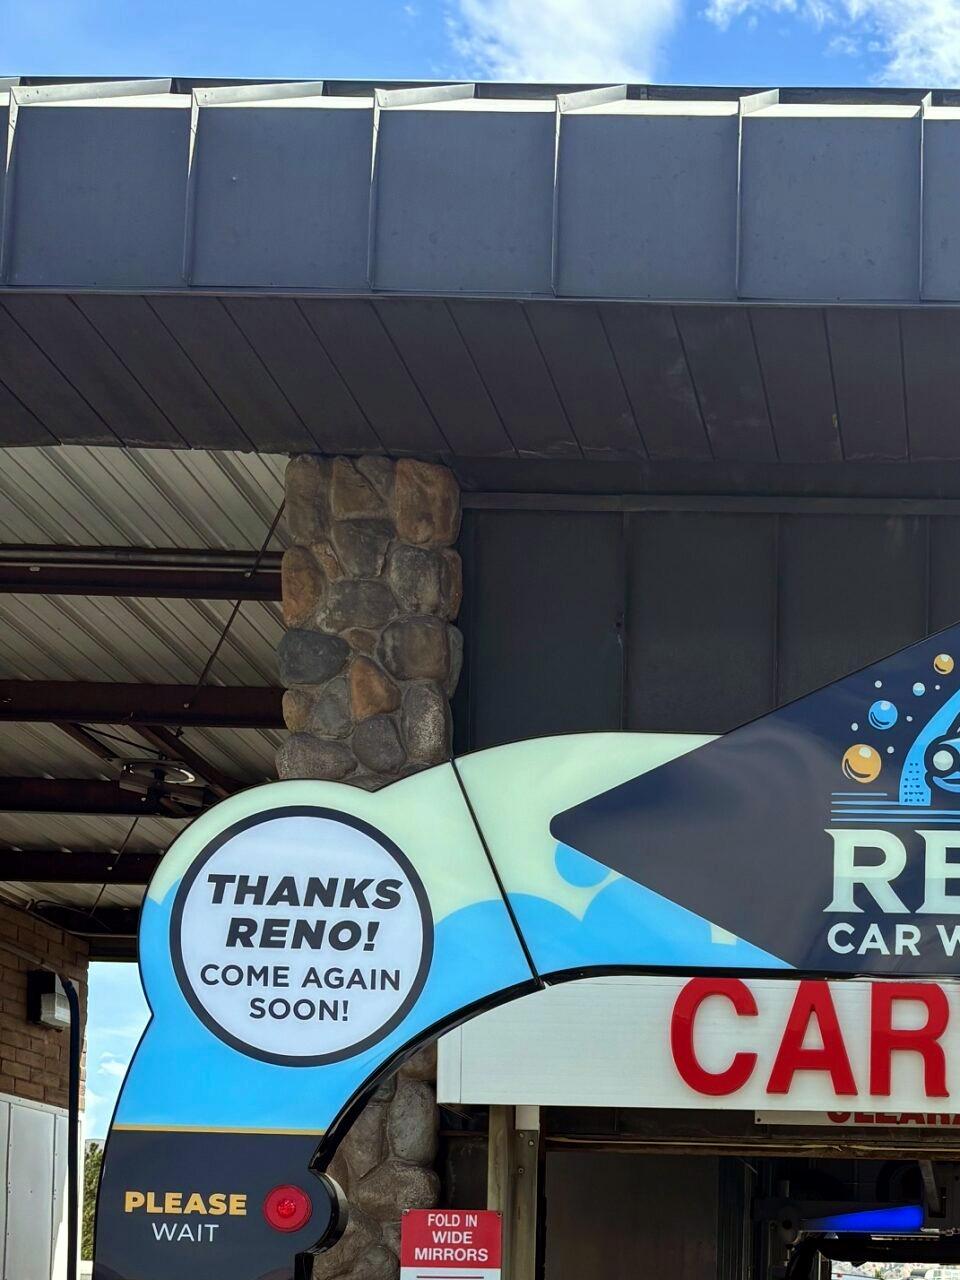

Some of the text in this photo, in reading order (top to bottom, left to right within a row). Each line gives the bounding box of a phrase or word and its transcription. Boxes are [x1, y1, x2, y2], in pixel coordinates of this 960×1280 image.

[207, 873, 403, 910] THANKS
[225, 917, 380, 951] RENO!
[827, 922, 920, 955] CAR
[200, 963, 401, 991] COME AGAIN
[249, 997, 349, 1022] SOON!
[124, 1191, 247, 1216] PLEASE
[152, 1222, 219, 1242] WAIT
[428, 1213, 478, 1227] FOLD IN
[432, 1231, 473, 1244] WIDE
[414, 1248, 489, 1262] MIRRORS
